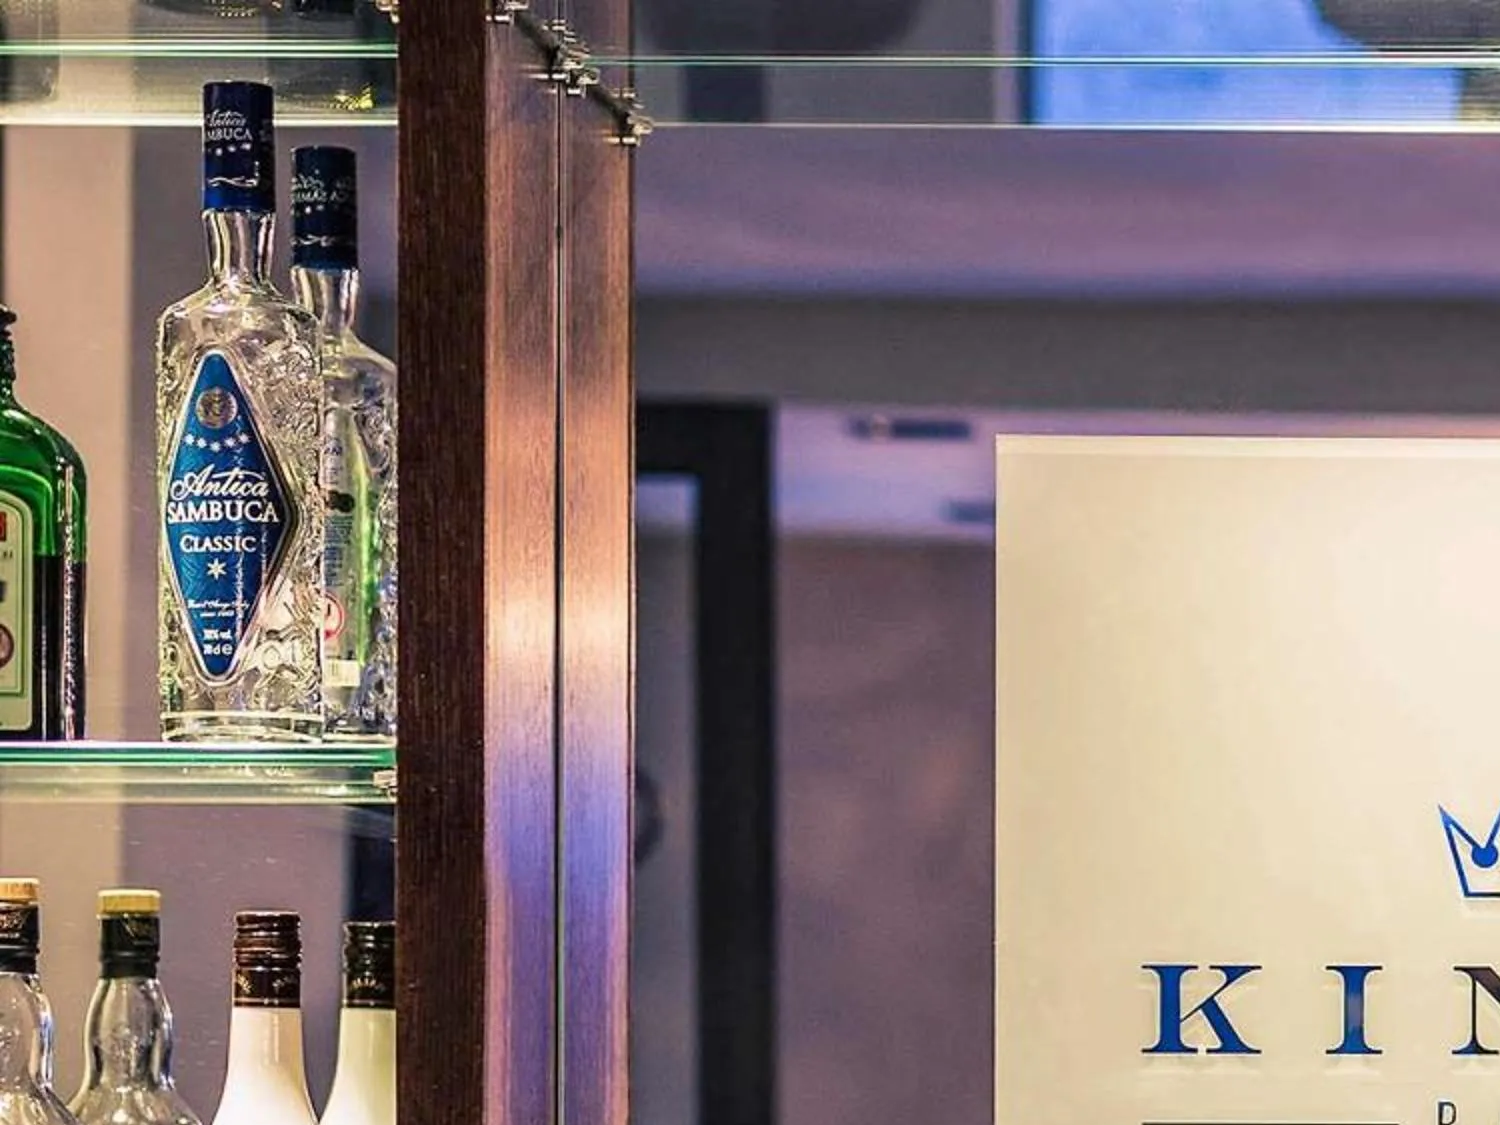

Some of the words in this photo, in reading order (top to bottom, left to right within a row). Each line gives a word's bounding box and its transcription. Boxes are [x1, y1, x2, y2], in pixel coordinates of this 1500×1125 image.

[170, 463, 270, 501] Antica
[167, 500, 280, 524] SAMBUCA
[180, 534, 257, 553] CLASSIC
